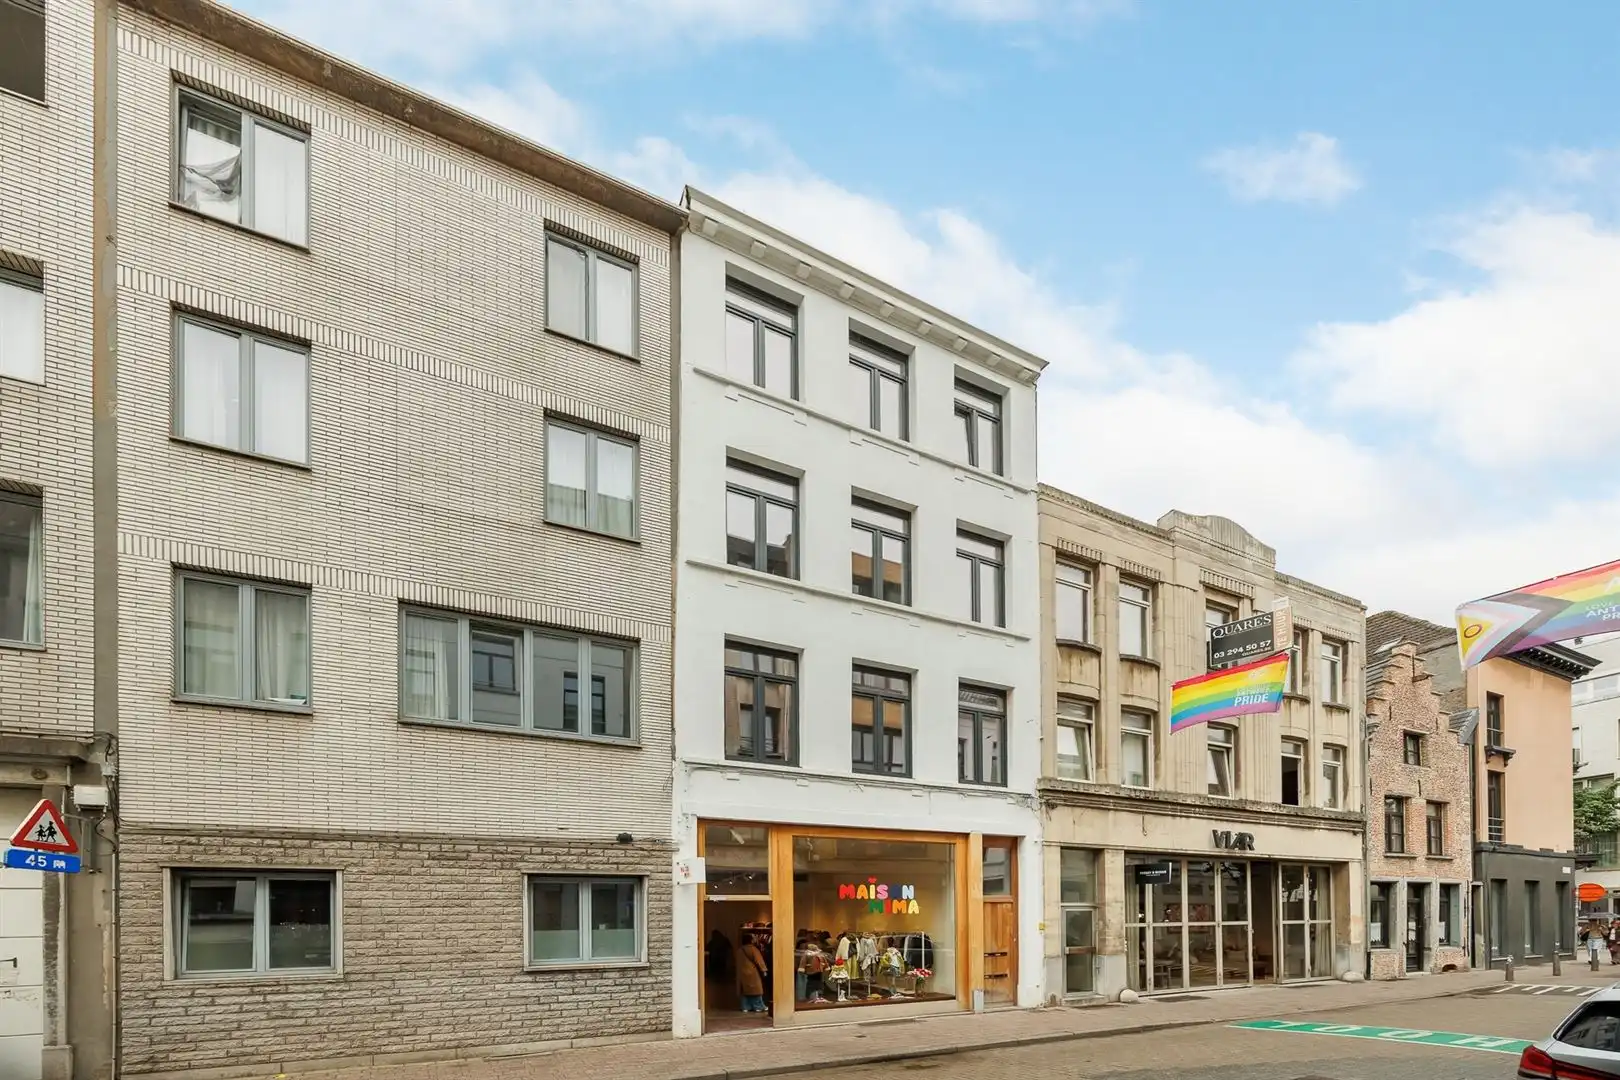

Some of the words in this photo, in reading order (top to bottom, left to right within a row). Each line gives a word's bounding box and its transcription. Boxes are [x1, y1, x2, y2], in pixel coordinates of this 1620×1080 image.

[1586, 605, 1620, 618] ANT
[1212, 615, 1272, 639] QUARES
[1214, 651, 1225, 659] 03
[1226, 646, 1244, 656] 294
[1246, 643, 1257, 651] 50
[1260, 640, 1271, 648] 57
[1234, 693, 1269, 707] PRIDE
[25, 854, 47, 867] 45
[53, 859, 66, 869] m
[869, 899, 919, 914] MIMA
